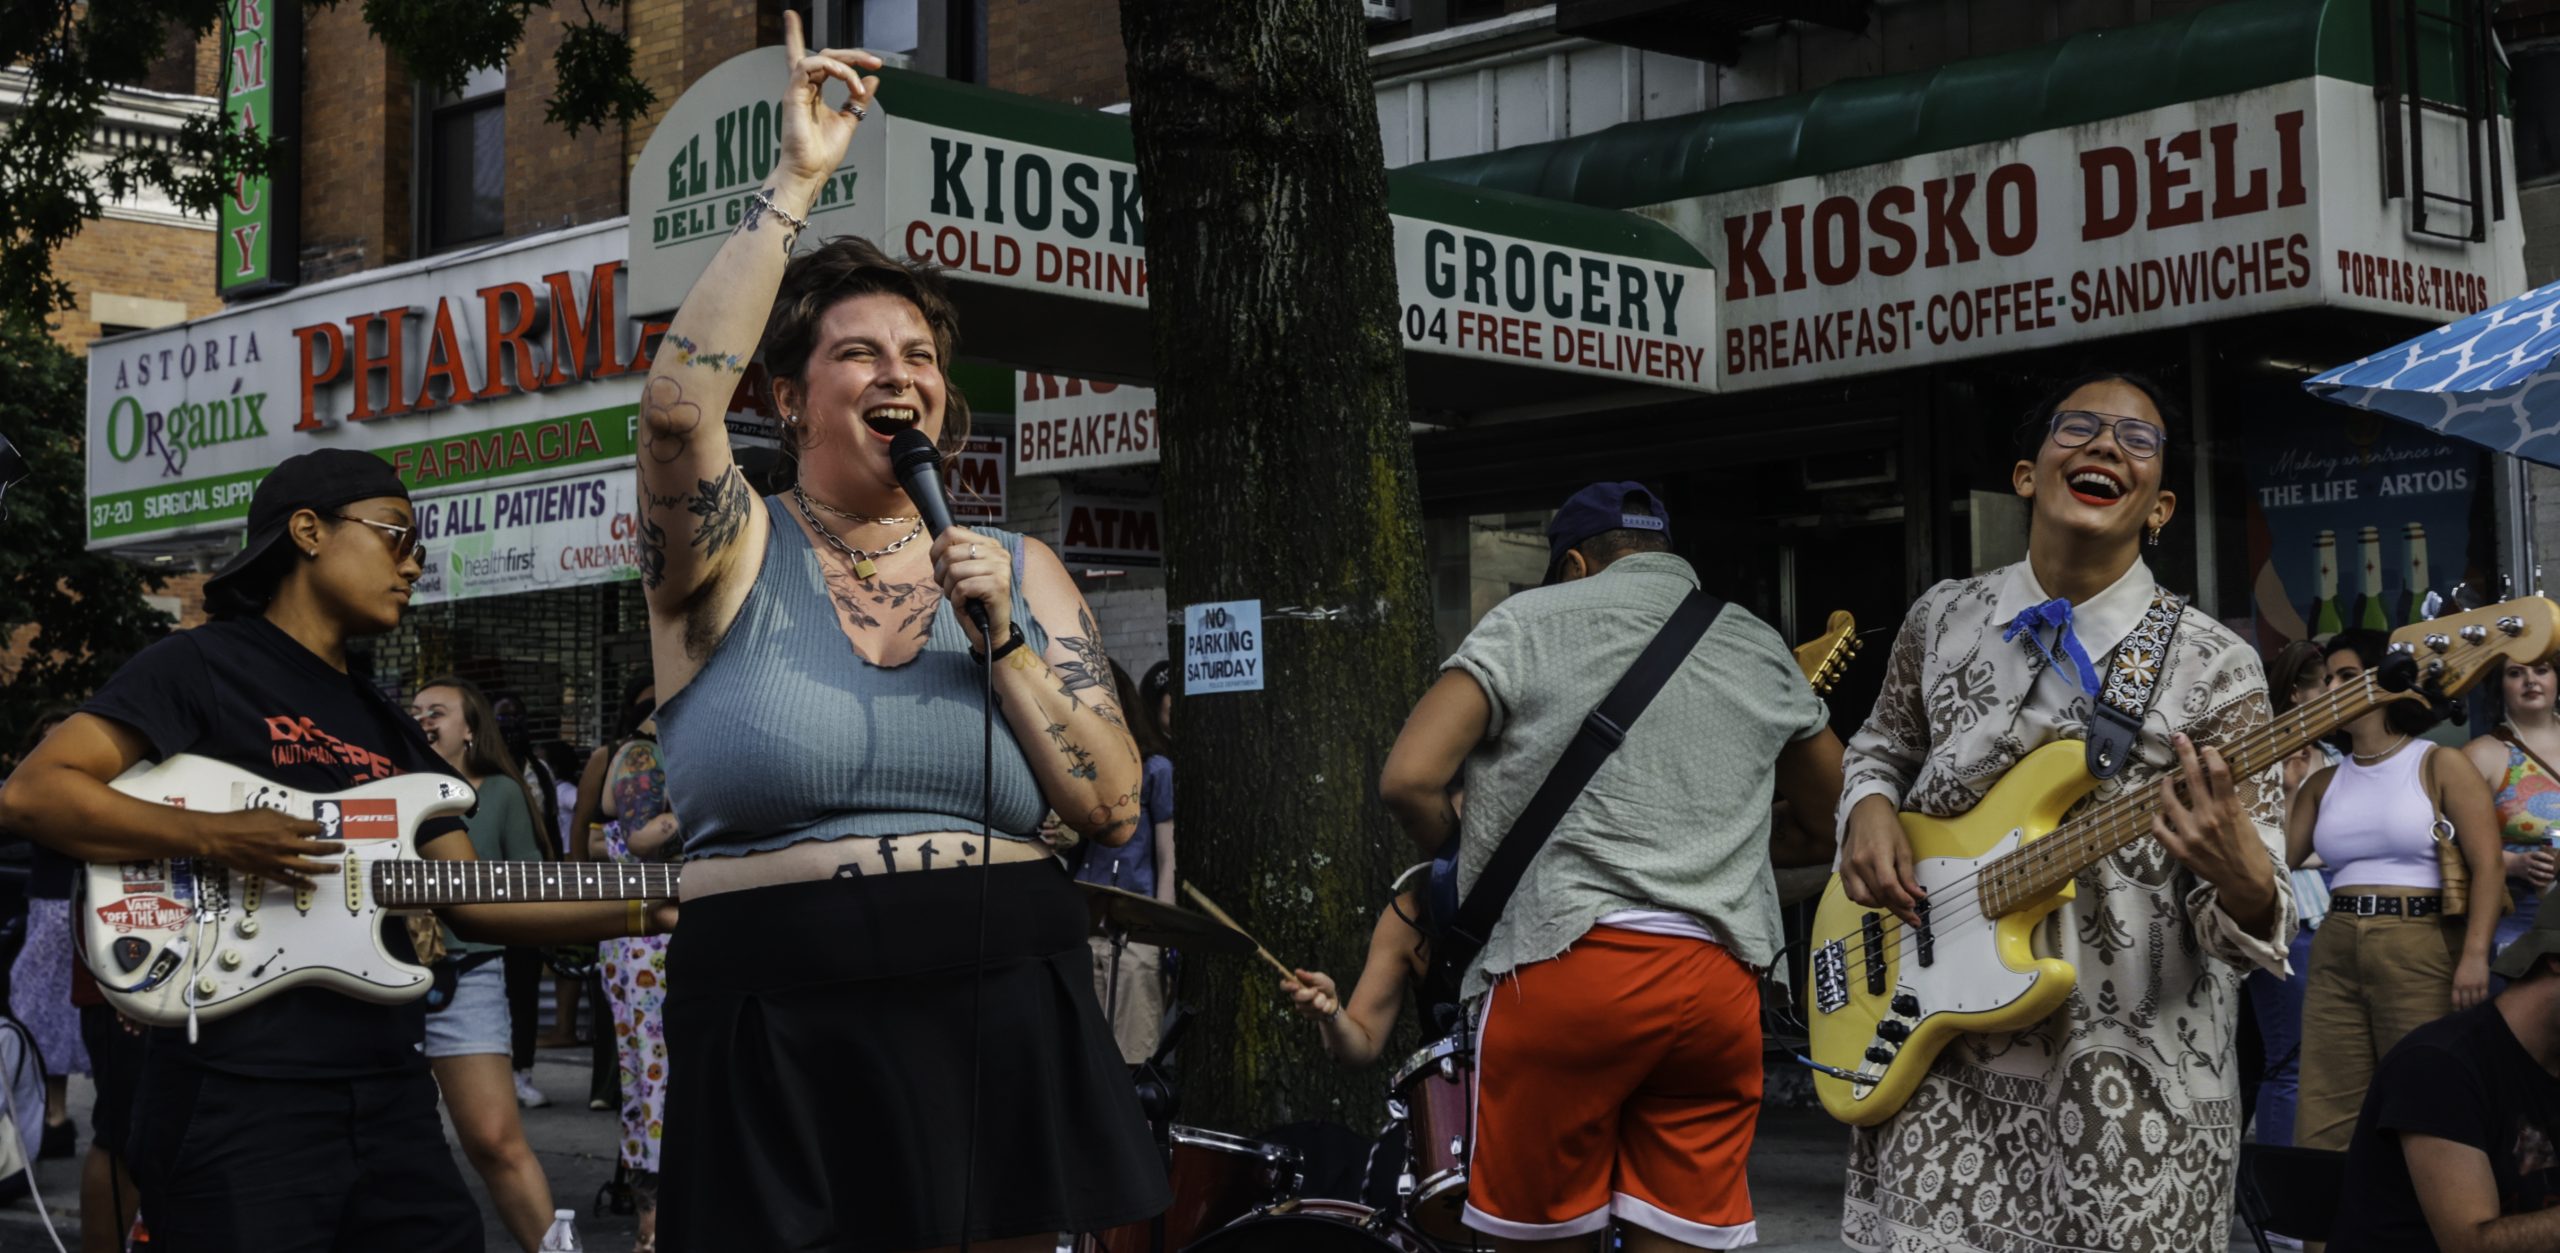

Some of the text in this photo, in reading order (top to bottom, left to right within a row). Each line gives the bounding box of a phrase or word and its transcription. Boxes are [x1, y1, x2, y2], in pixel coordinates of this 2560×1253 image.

[668, 134, 707, 201] EL
[715, 100, 783, 190] KIO
[653, 204, 715, 243] DELI
[1724, 110, 2307, 301] KIOSKO DELI
[905, 220, 1021, 277] COLD
[1425, 228, 1684, 337] GROCERY
[115, 331, 261, 390] ASTORIA
[1399, 303, 1704, 383] 04 FREE DELIVERY
[394, 419, 602, 482] FARMACIA
[1020, 408, 1159, 463] BREAKFAST
[2269, 444, 2454, 480] Making an entrance in
[93, 500, 133, 528] 37-20
[144, 487, 209, 519] SURGICAL
[444, 498, 486, 537] ALL
[494, 479, 606, 530] PATIENTS
[2259, 467, 2468, 508] THE LIFE ARTOIS
[1064, 506, 1160, 551] ATM
[1189, 630, 1253, 656] PARKING
[1205, 607, 1226, 629] NO
[1188, 658, 1256, 682] SATURDAY
[130, 910, 155, 926] THE
